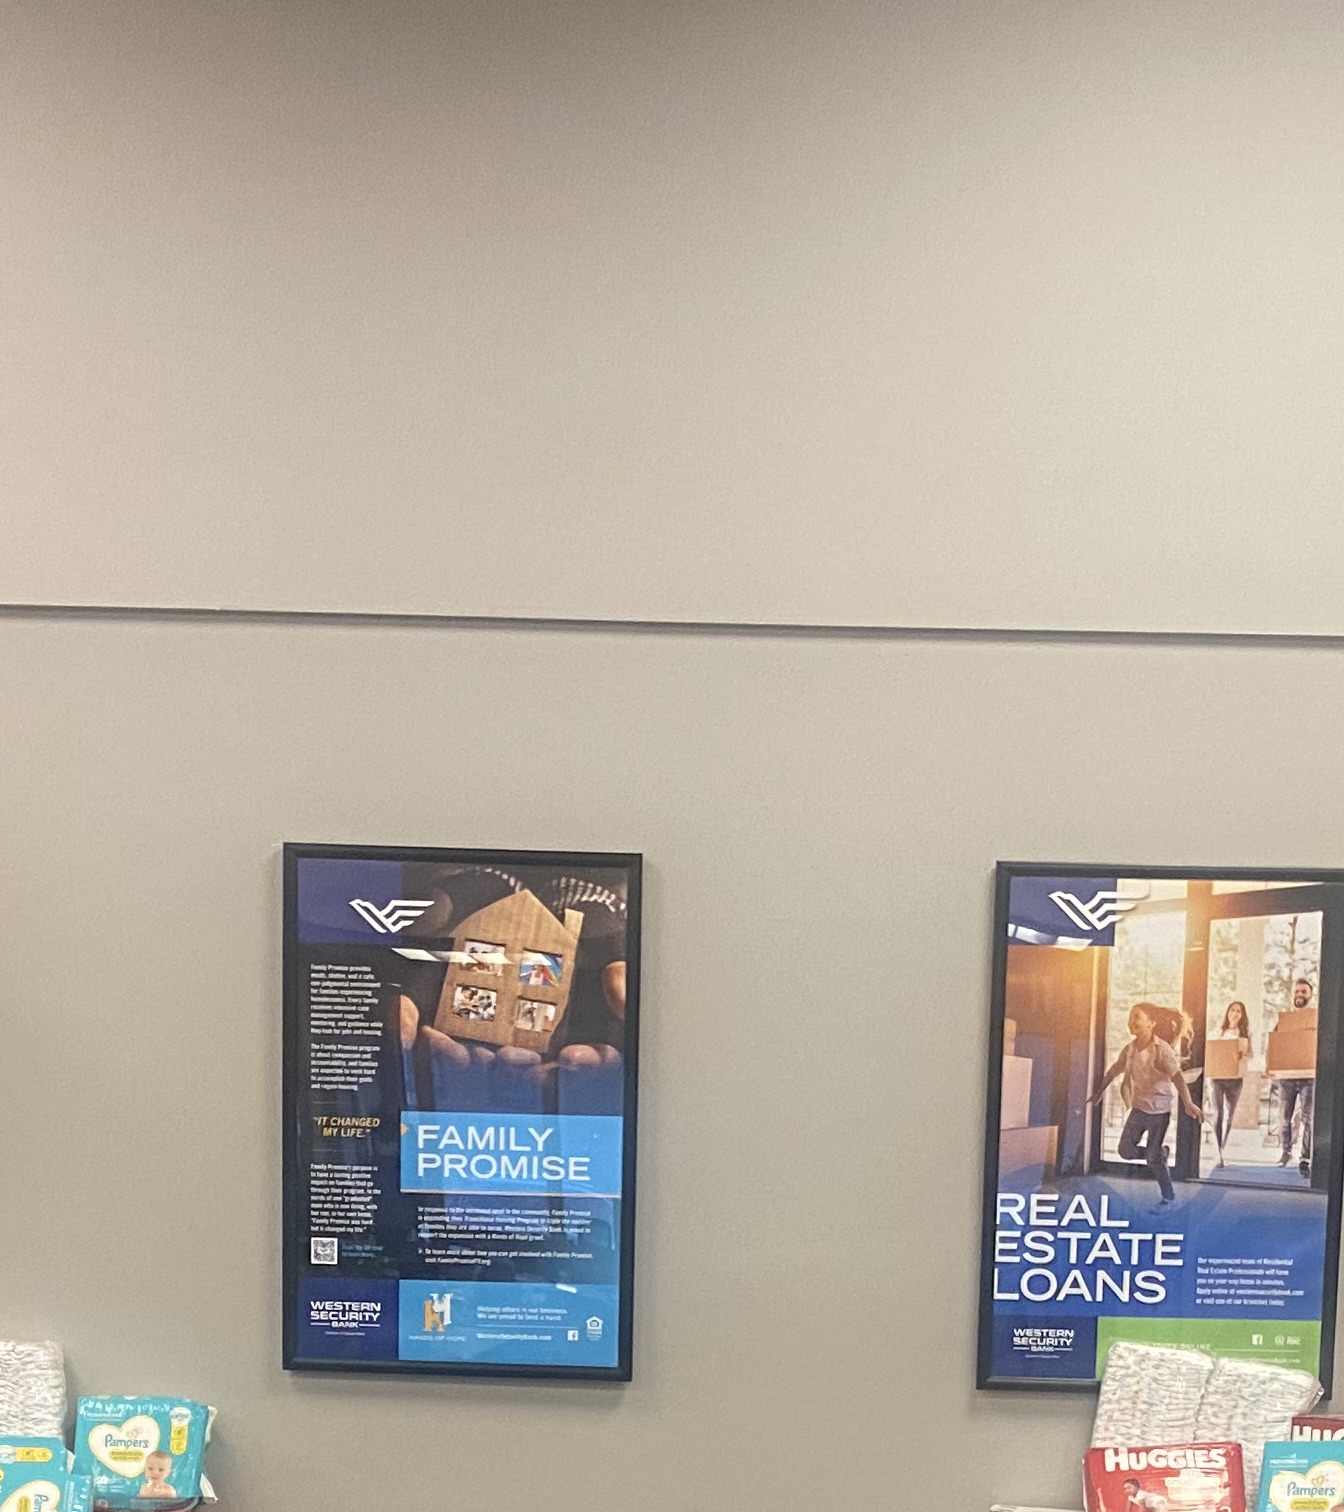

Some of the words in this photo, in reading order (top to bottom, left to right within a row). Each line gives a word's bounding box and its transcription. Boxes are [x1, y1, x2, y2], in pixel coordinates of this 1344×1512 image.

[330, 1117, 380, 1127] CHANGED
[323, 1127, 338, 1137] MY
[418, 1125, 554, 1151] FAMILY
[418, 1153, 591, 1181] PROMISE
[996, 1192, 1130, 1228] REAL
[995, 1230, 1184, 1266] ESTATE
[993, 1268, 1167, 1304] LOANS
[310, 1301, 381, 1311] WESTERN
[310, 1311, 380, 1321] SECURITY
[1013, 1328, 1074, 1337] WESTERN
[1013, 1337, 1073, 1346] SECURITY
[105, 1434, 150, 1450] Pampers
[1104, 1446, 1227, 1472] HUGGIES
[1287, 1481, 1336, 1498] Pampers
